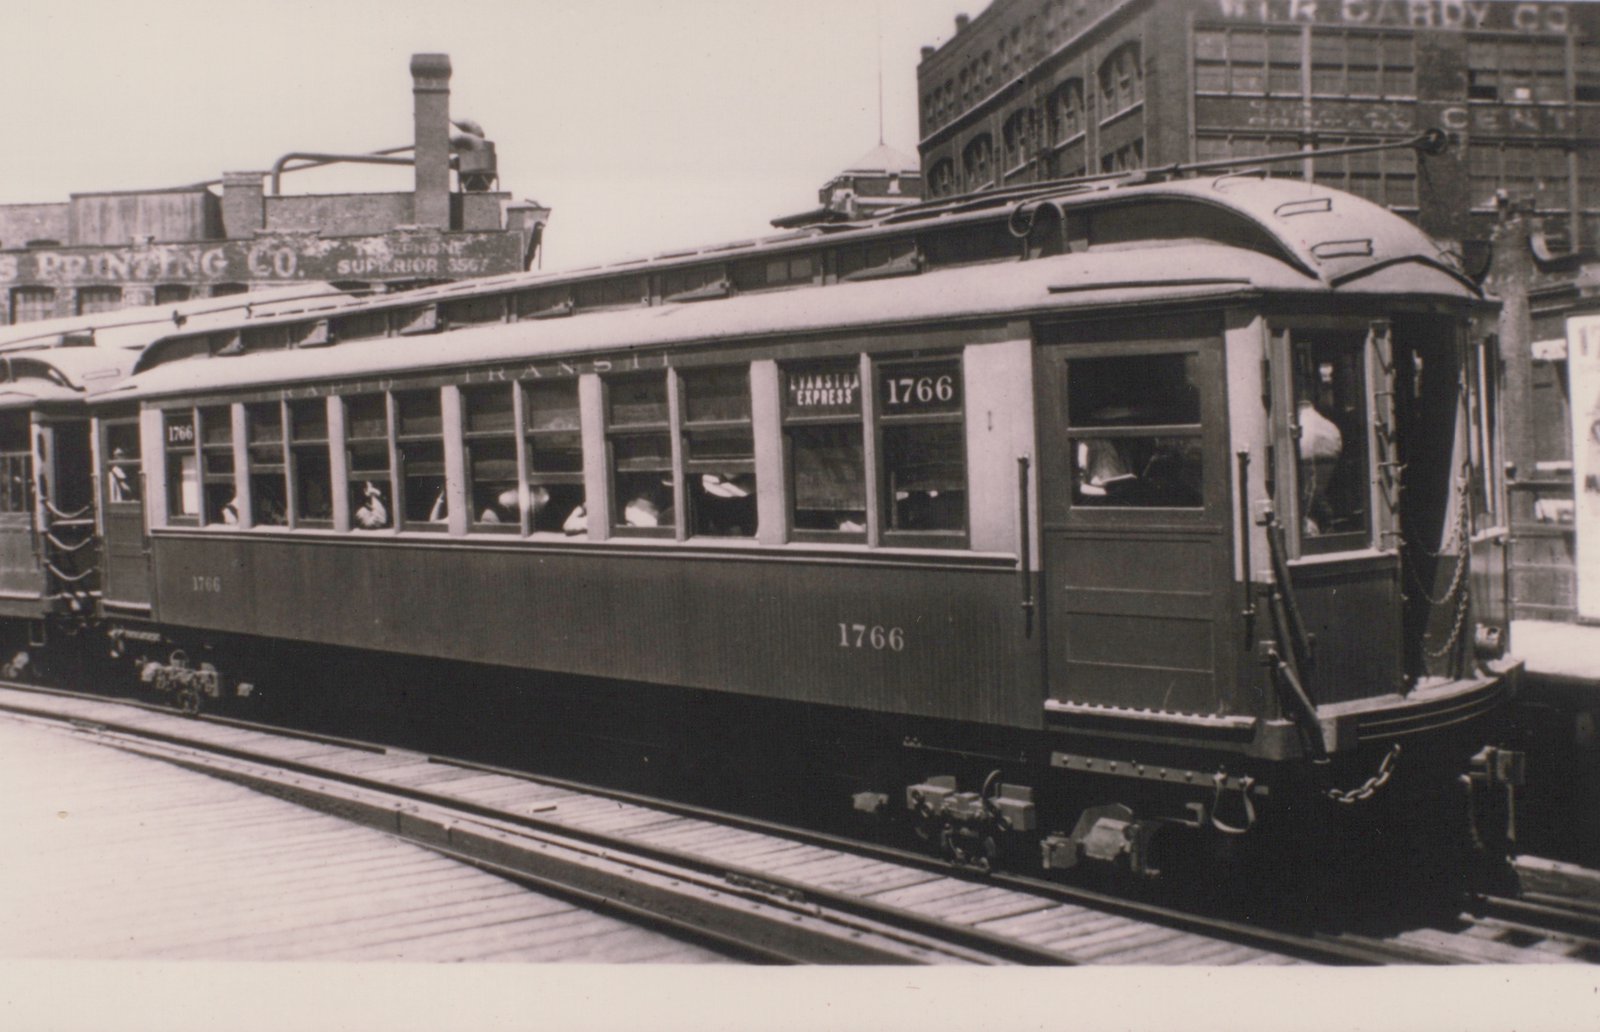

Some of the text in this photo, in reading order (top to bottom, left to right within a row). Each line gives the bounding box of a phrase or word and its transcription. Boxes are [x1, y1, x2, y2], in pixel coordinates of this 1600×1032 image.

[36, 247, 229, 281] PRINTING
[247, 245, 305, 278] CO.
[336, 256, 438, 275] SUPERIOR
[280, 352, 669, 399] RAPID TRANSIT
[797, 388, 852, 406] EXPRESS
[887, 375, 953, 404] 1766
[168, 425, 193, 442] 1766
[192, 576, 221, 593] 1766
[838, 623, 904, 652] 1766
